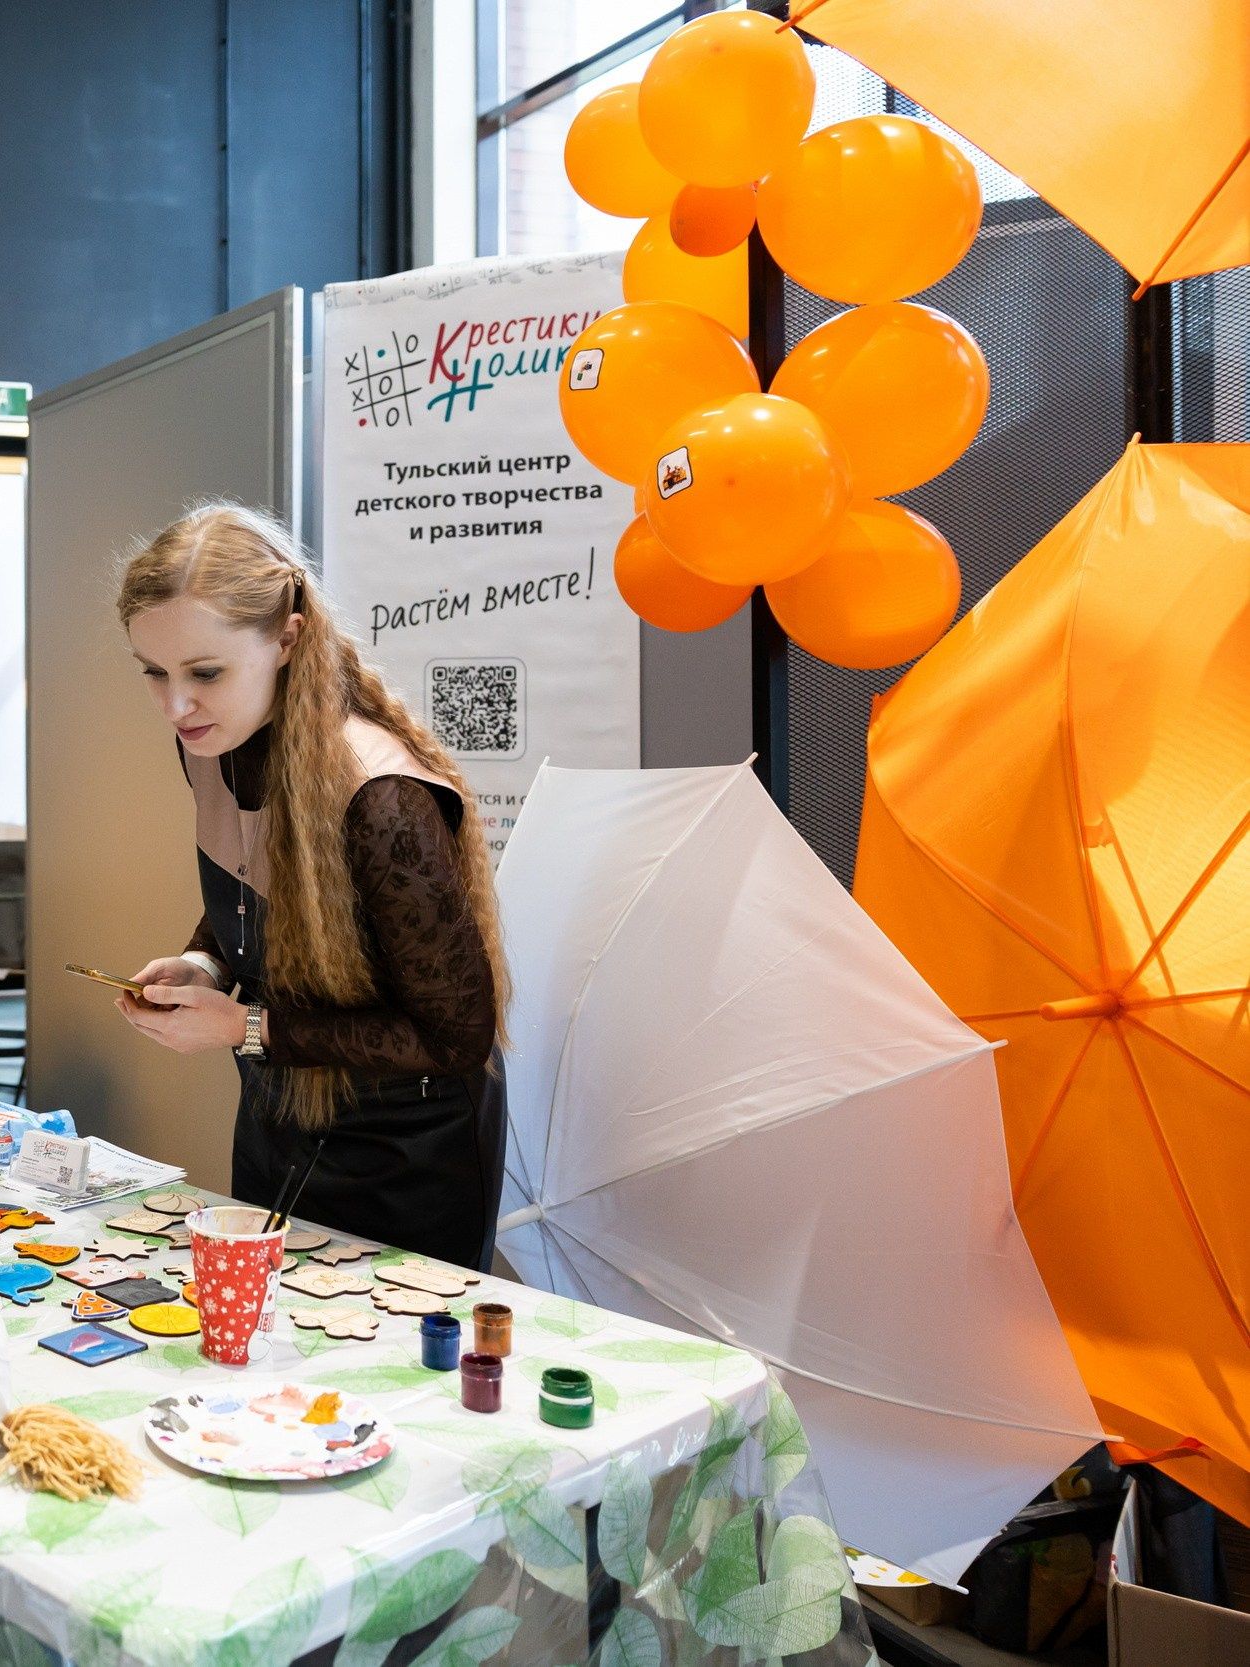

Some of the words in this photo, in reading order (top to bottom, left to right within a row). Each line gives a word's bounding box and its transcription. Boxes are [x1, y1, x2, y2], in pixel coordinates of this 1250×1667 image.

[427, 344, 572, 422] Нолик
[383, 455, 491, 485] Тульский
[498, 453, 571, 476] центр
[355, 491, 456, 516] детского
[463, 483, 603, 513] творчества
[409, 524, 423, 540] и
[429, 518, 543, 543] развития
[371, 588, 470, 646] растём
